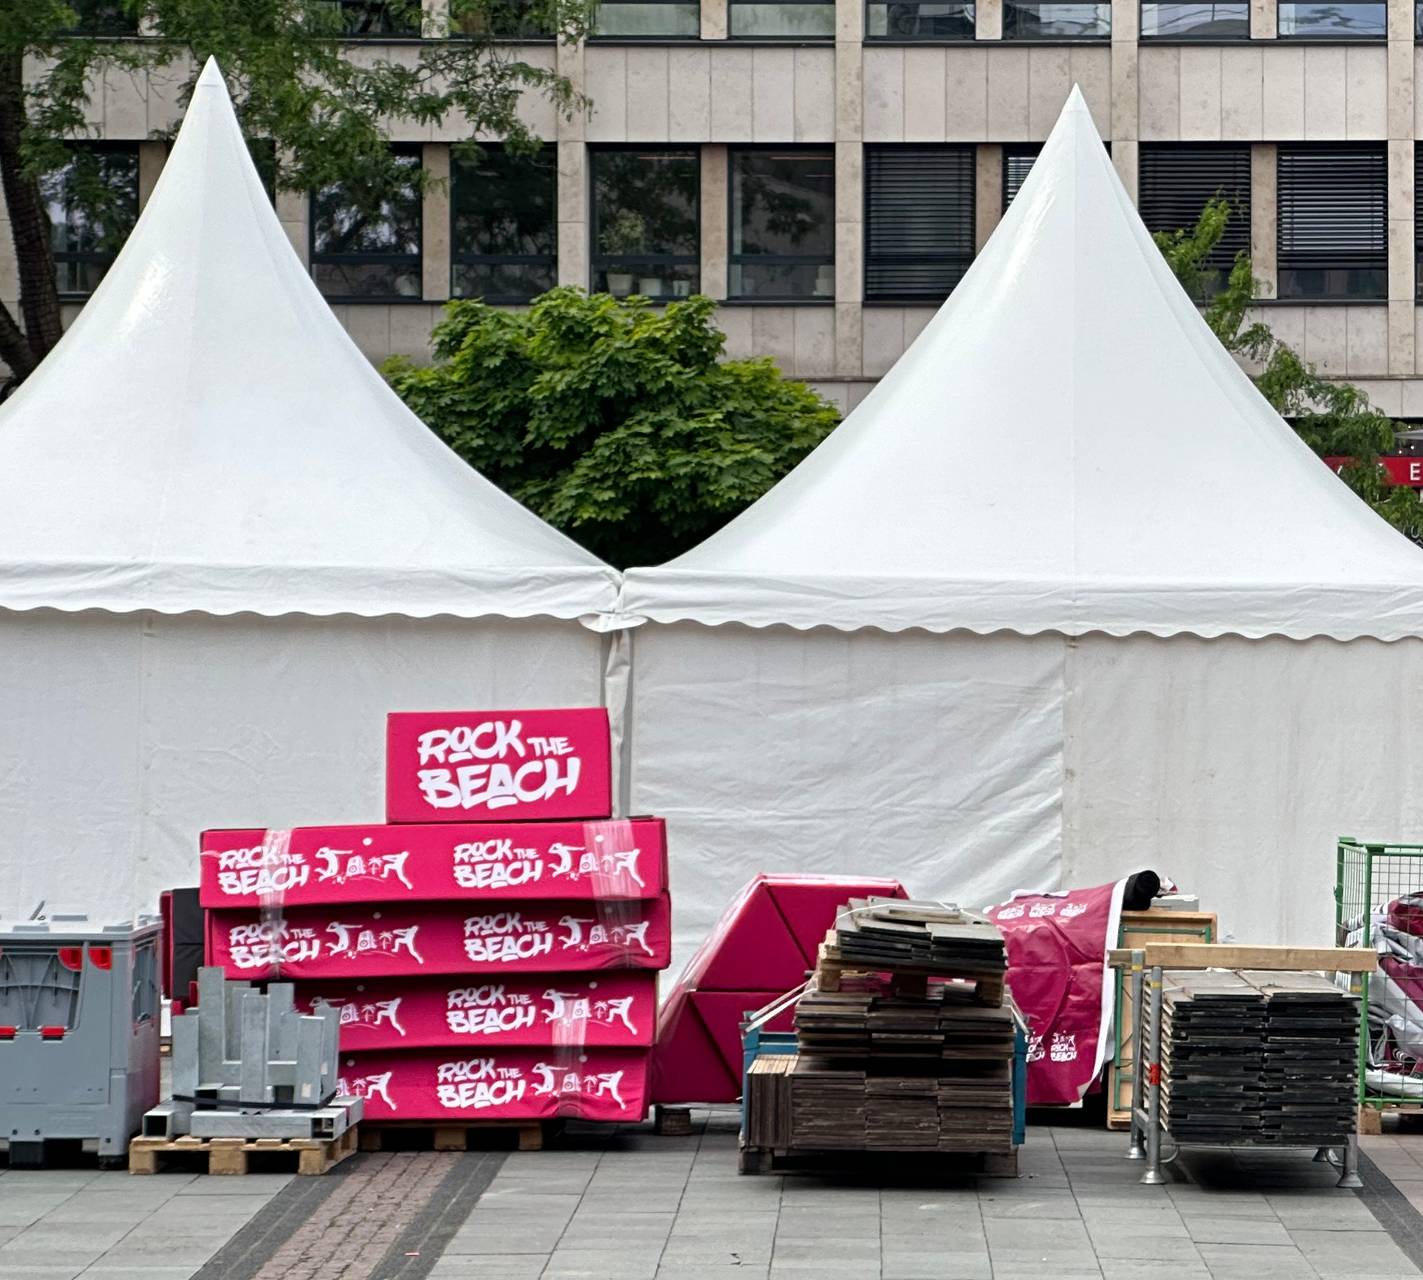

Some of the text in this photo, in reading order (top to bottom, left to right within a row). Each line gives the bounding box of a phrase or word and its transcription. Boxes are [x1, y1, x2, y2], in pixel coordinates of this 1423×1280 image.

[417, 719, 575, 766] ROCK THE
[416, 757, 582, 810] BEACH
[218, 845, 308, 871] ROCK THE
[453, 838, 541, 864] ROCK THE
[217, 864, 310, 896] BEACH
[452, 859, 544, 889] BEACH
[229, 918, 317, 946] ROCK THE
[463, 911, 550, 937] ROCK THE
[228, 939, 321, 969] BEACH
[463, 932, 554, 963] BEACH
[447, 984, 533, 1009] ROCK THE
[446, 1005, 537, 1035] BEACH
[437, 1057, 524, 1084] ROCK THE
[436, 1079, 526, 1109] BEACH
